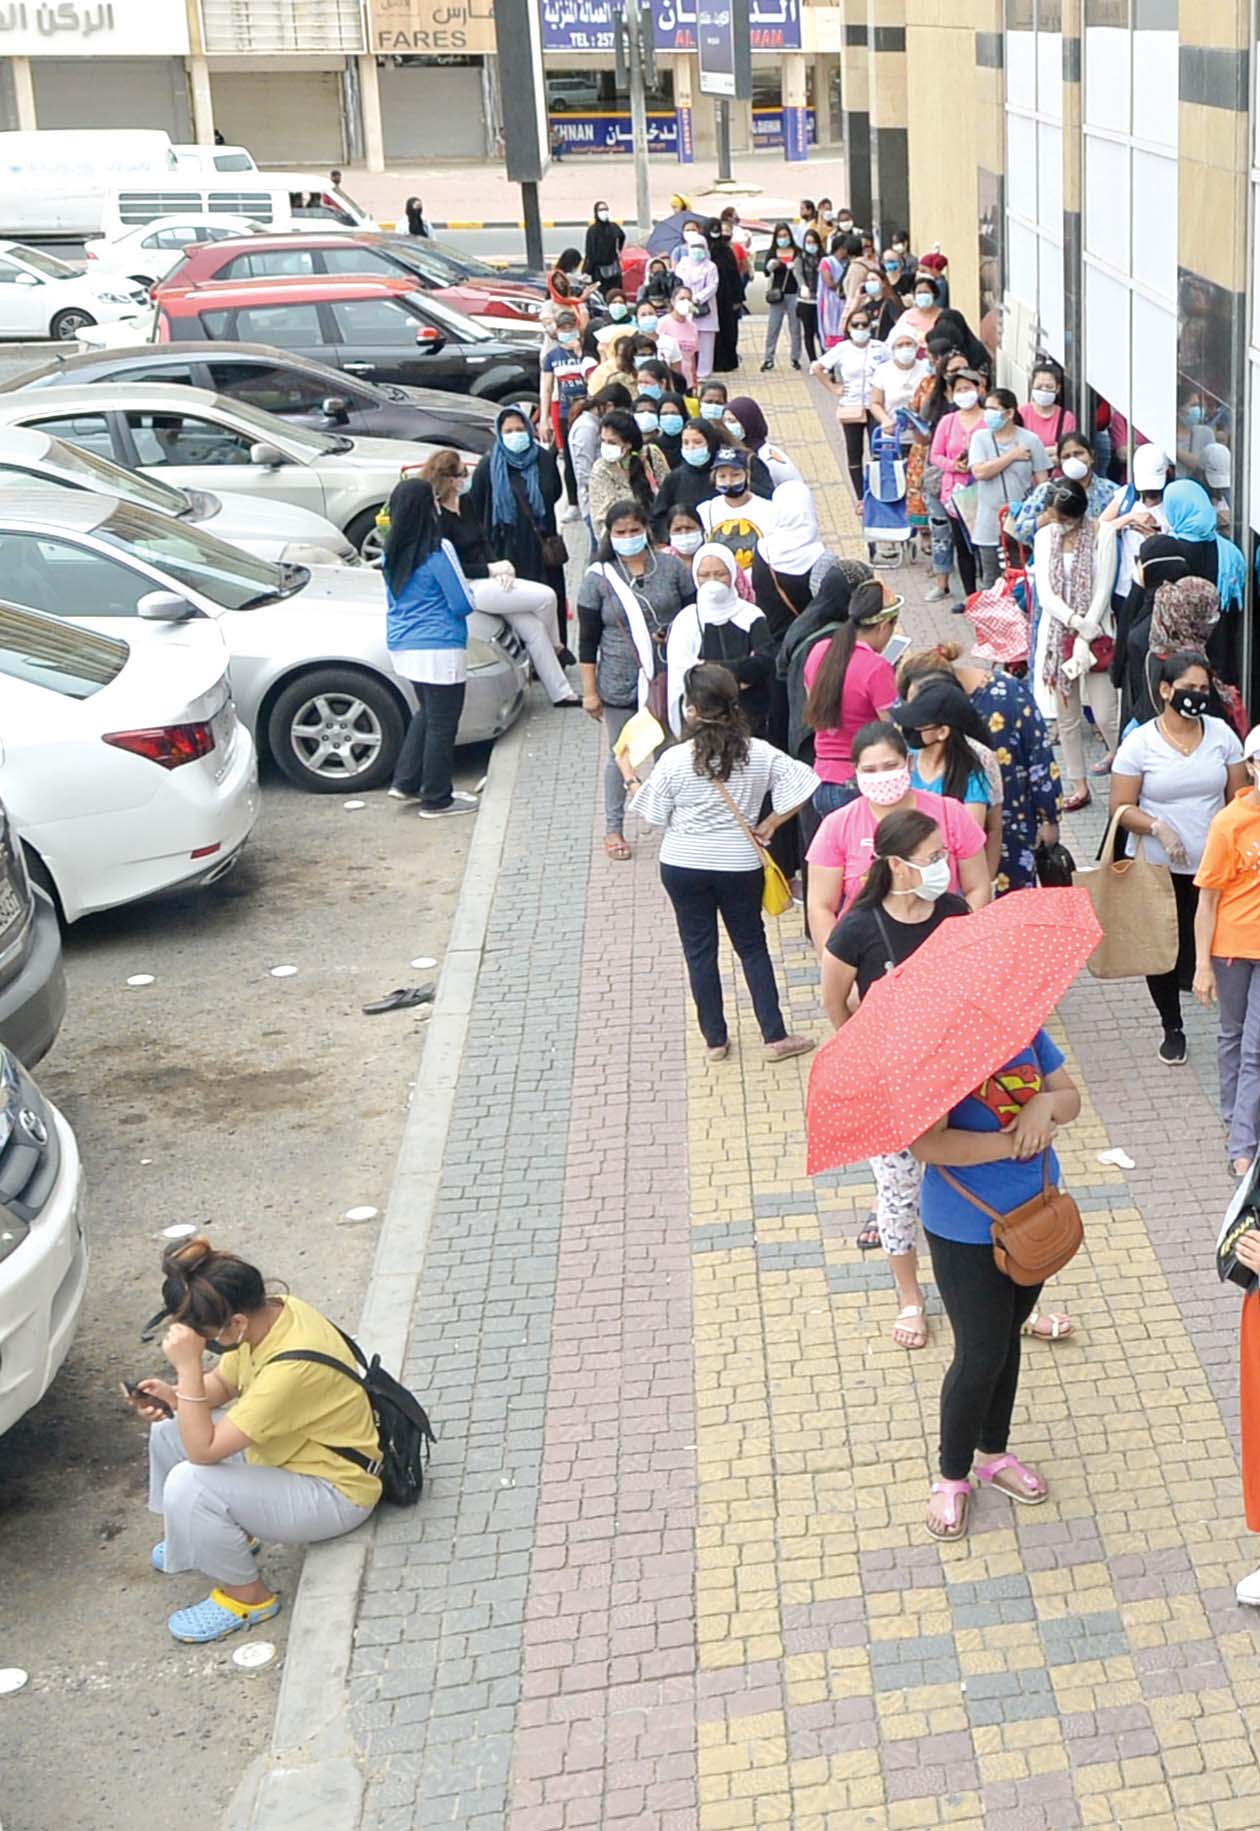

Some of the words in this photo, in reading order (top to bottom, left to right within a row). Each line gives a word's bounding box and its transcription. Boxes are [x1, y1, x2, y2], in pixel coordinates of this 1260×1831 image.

[37, 2, 114, 37] الركن
[378, 30, 466, 48] FARES
[570, 32, 589, 47] TEL
